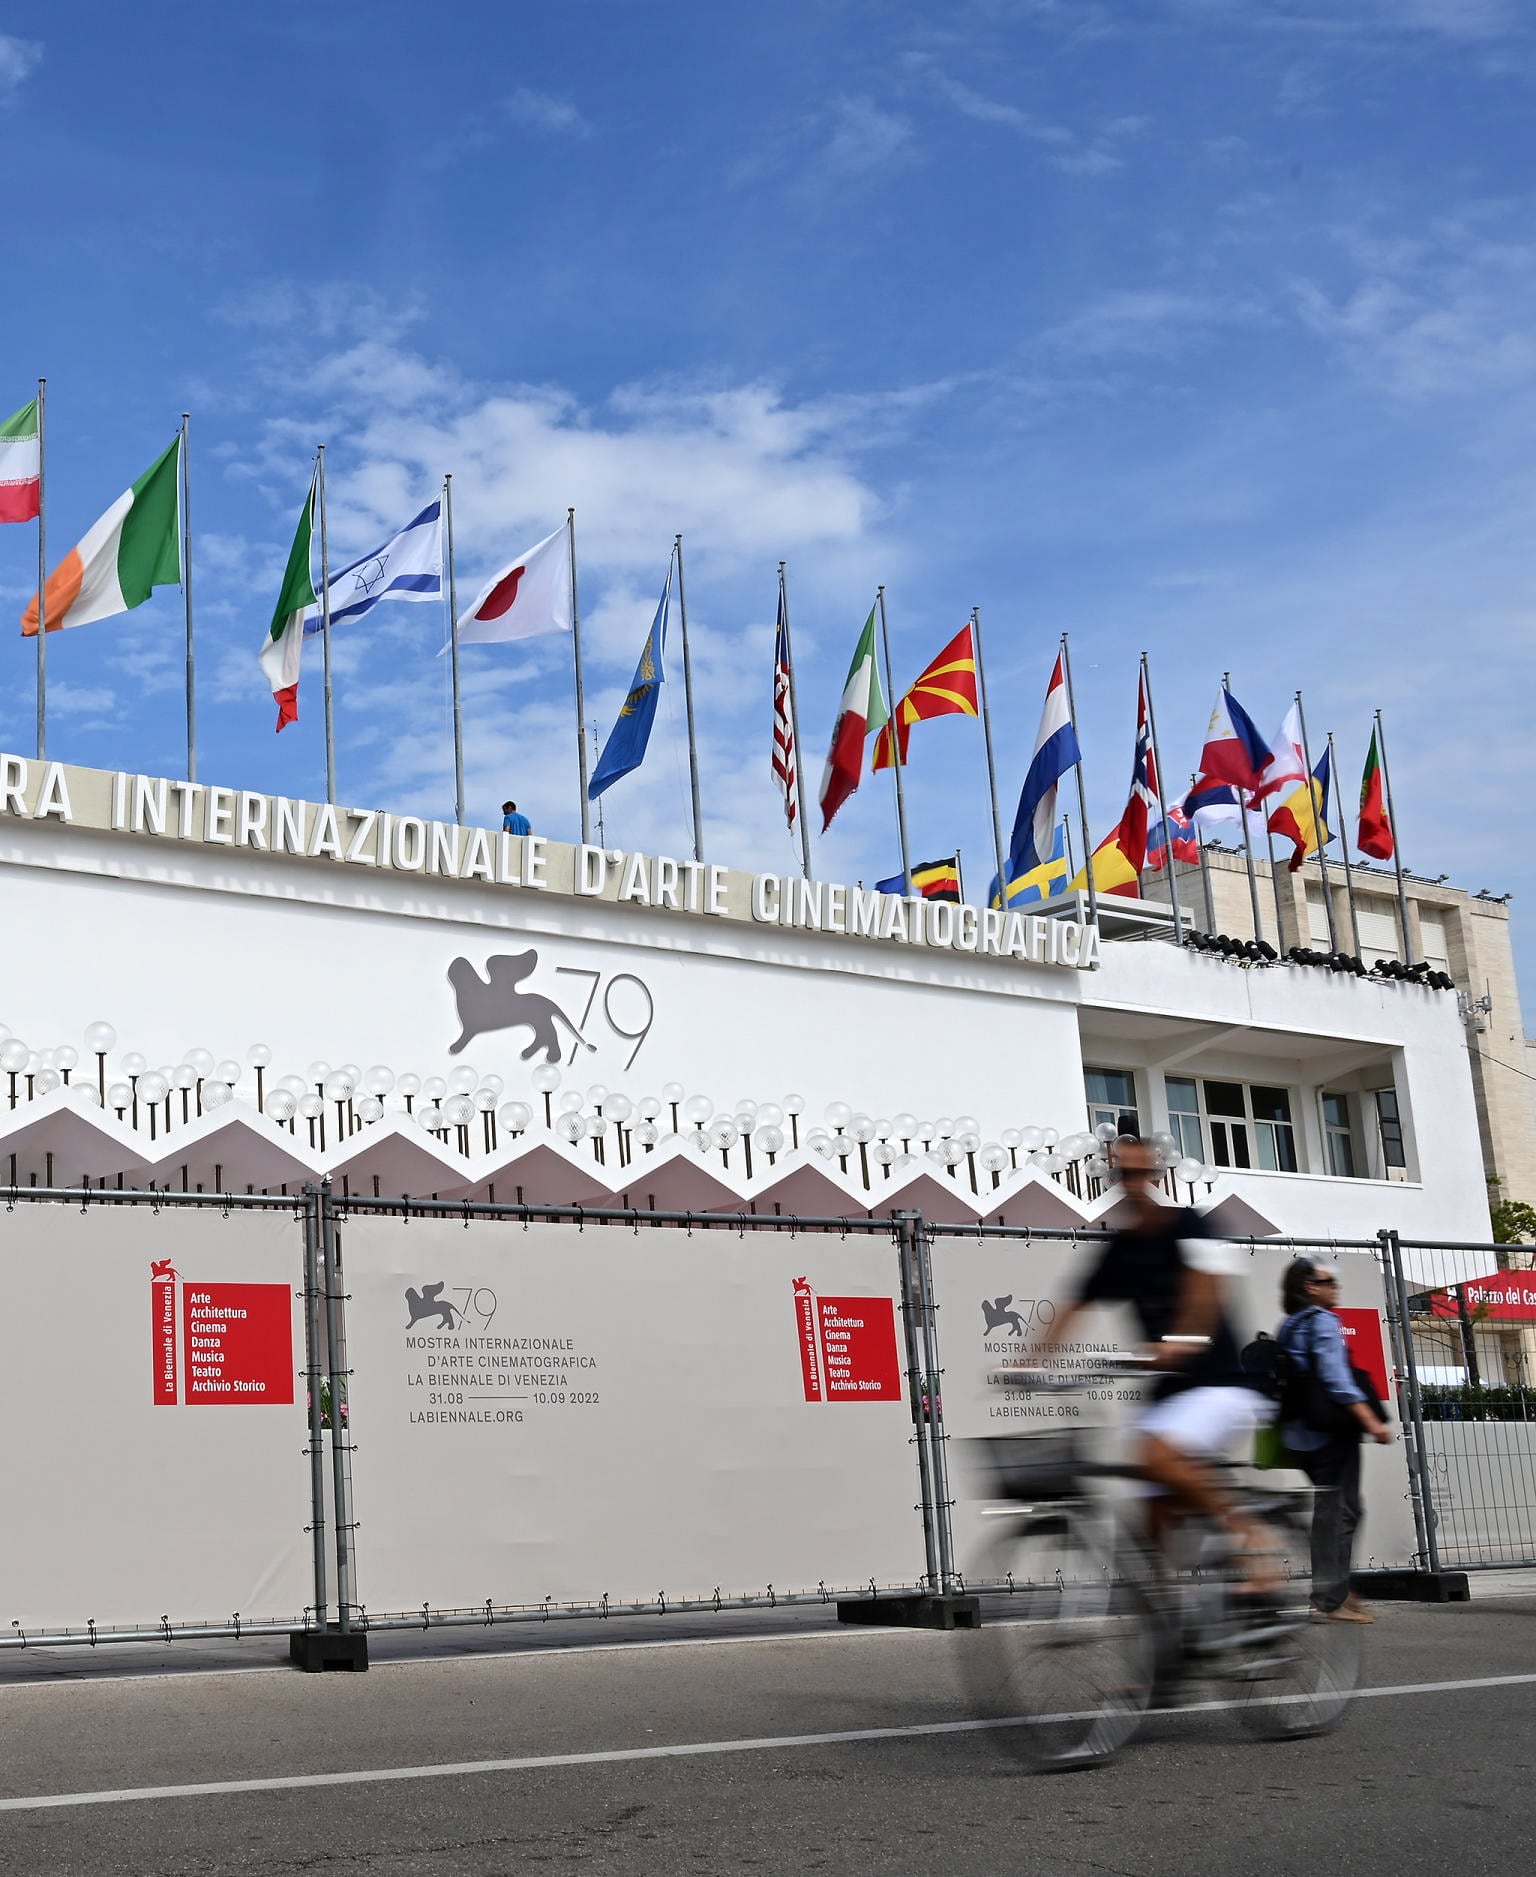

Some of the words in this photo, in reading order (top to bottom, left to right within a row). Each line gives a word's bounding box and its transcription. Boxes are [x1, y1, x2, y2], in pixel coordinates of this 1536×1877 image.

[111, 771, 548, 889] INTERNAZIONALE
[574, 843, 728, 914] D'ARTE
[751, 872, 1102, 969] CINEMATOGRAFICA
[555, 966, 654, 1071] 79
[191, 1293, 210, 1303] Arte
[1468, 1285, 1503, 1304] Palazzo
[1506, 1287, 1520, 1304] del
[163, 1286, 172, 1322] Venezia
[453, 1288, 496, 1330] 79
[823, 1305, 837, 1314] Arte
[191, 1307, 247, 1318] Architettura
[1019, 1300, 1055, 1336] 79
[191, 1321, 226, 1333] Cinema
[824, 1317, 864, 1328] Architettura
[163, 1326, 172, 1334] di
[826, 1330, 850, 1340] Cinema
[192, 1337, 220, 1347] Danza
[407, 1337, 460, 1348] MOSTRA
[466, 1338, 573, 1349] INTERNAZIONALE
[827, 1342, 847, 1352] Danza
[985, 1343, 1026, 1352] MOSTRA
[1031, 1344, 1117, 1353] INTERNAZIONALE
[164, 1337, 173, 1379] Biennale
[192, 1351, 224, 1362] Musica
[428, 1356, 473, 1367] D'ARTE
[479, 1356, 596, 1368] CINEMATOGRAFICA
[828, 1355, 851, 1365] Musica
[1002, 1359, 1038, 1368] D'ARTE
[192, 1366, 221, 1377] Teatro
[829, 1368, 850, 1377] Teatro
[192, 1380, 230, 1391] Archivio
[234, 1381, 265, 1391] Storico
[408, 1375, 423, 1385] LA
[429, 1375, 493, 1385] BIENNALE
[498, 1375, 510, 1385] DI
[515, 1375, 567, 1385] VENEZIA
[831, 1380, 857, 1390] Archivio
[859, 1380, 881, 1390] Storico
[987, 1376, 999, 1384] LA
[1004, 1376, 1054, 1384] BIENNALE
[1058, 1376, 1069, 1384] DI
[1071, 1376, 1114, 1384] VENEZIA
[166, 1382, 173, 1391] La
[430, 1393, 463, 1404] 31.08
[534, 1393, 565, 1403] 10.09
[570, 1393, 599, 1403] 2022
[1005, 1391, 1031, 1400] 31.08
[1087, 1391, 1113, 1400] 10.09
[1117, 1391, 1140, 1400] 2022
[990, 1406, 1079, 1416] LABIENNALE.ORG
[410, 1411, 523, 1423] LABIENNALE.ORG
